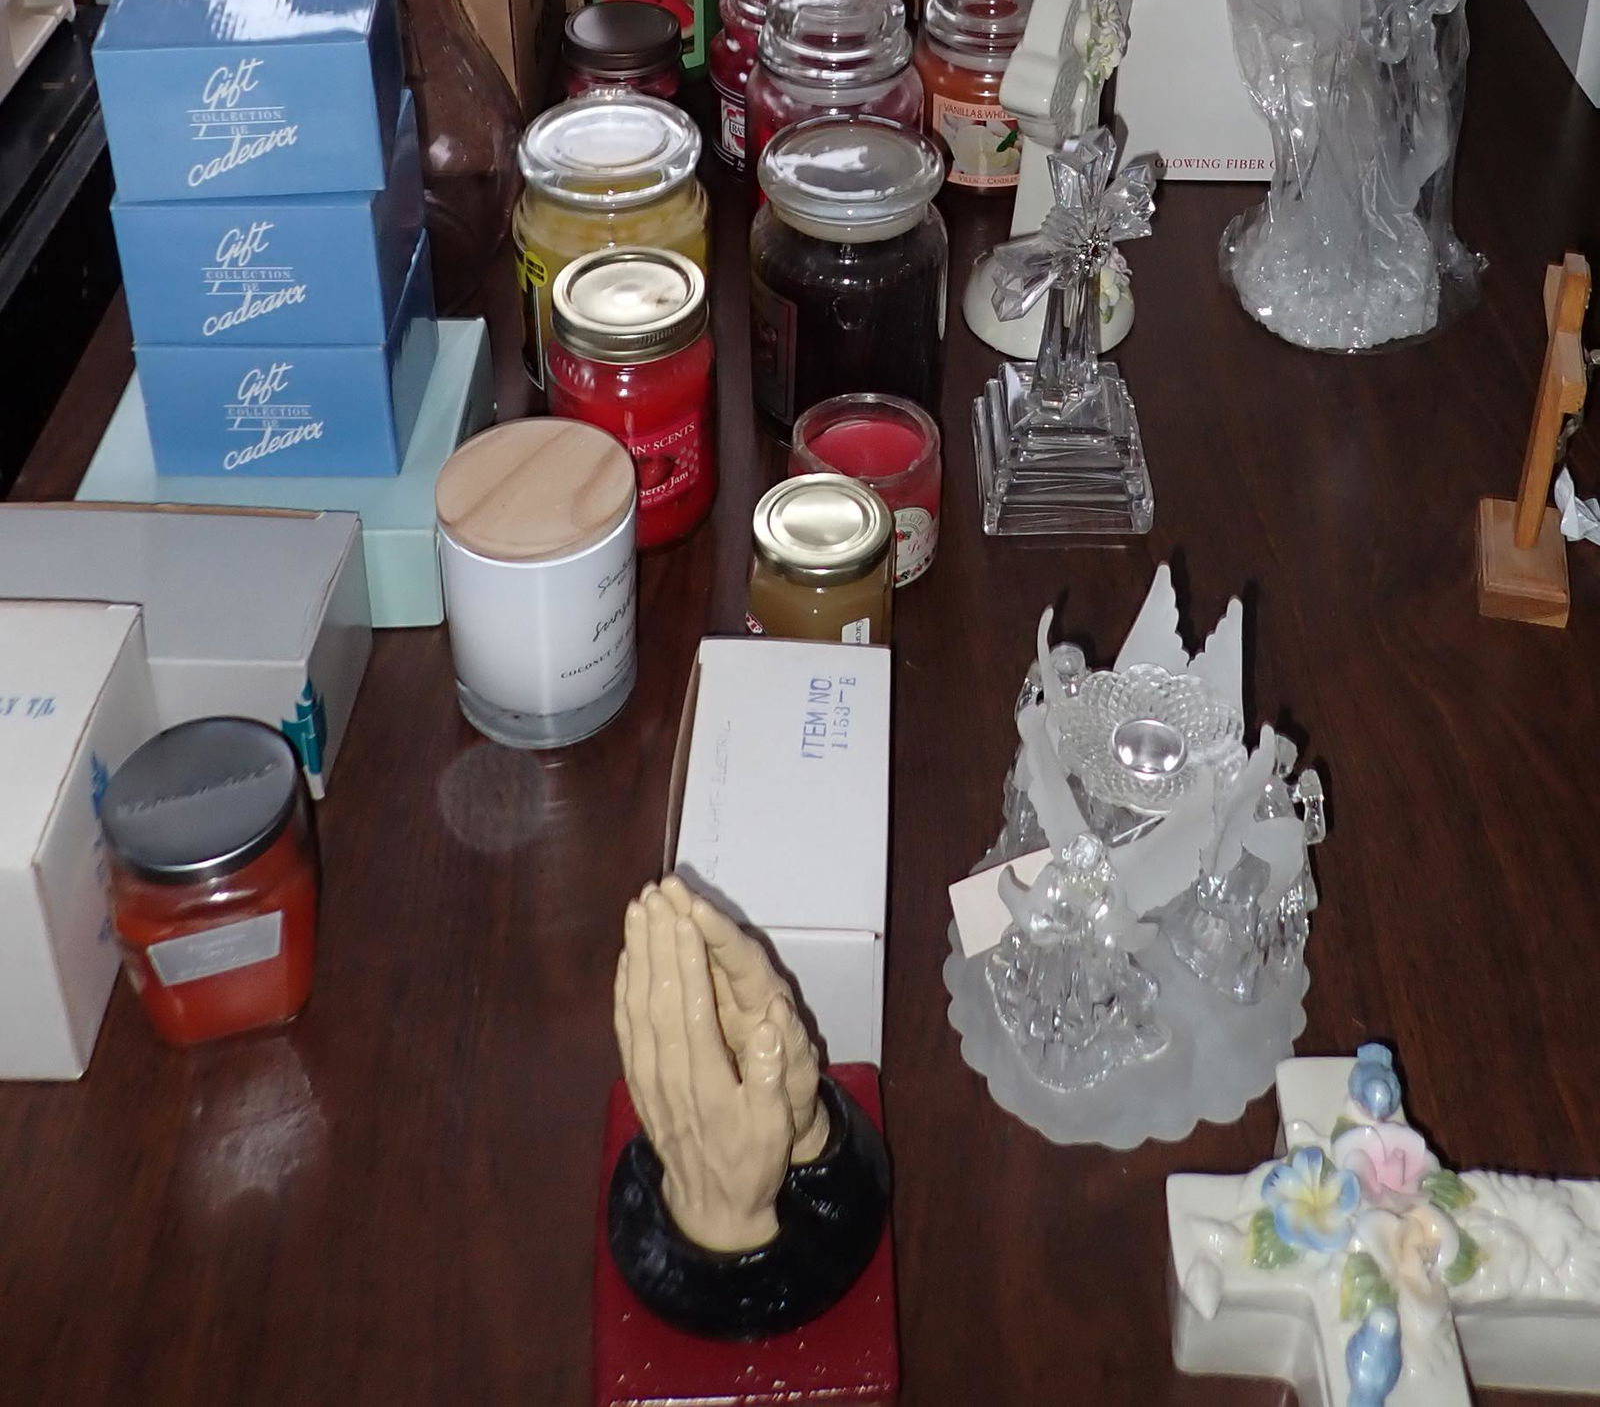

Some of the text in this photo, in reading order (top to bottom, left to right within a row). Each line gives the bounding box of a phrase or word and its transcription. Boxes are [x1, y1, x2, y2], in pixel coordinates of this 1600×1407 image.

[202, 58, 264, 110] Gift
[191, 108, 283, 123] COLLECTION
[230, 124, 249, 135] DE
[188, 124, 299, 187] cadeaux
[1154, 158, 1221, 170] GLOWING
[1226, 158, 1265, 170] FIBER
[215, 221, 275, 269] Gift
[205, 270, 291, 280] COLLECTION
[241, 281, 260, 292] DE
[202, 284, 307, 336] cadeaux
[237, 362, 294, 408] Gift
[227, 407, 310, 417] COLLECTION
[223, 421, 325, 470] cadeaux
[653, 421, 695, 451] SCENTS
[669, 471, 689, 489] Jam
[801, 710, 828, 760] ITEM
